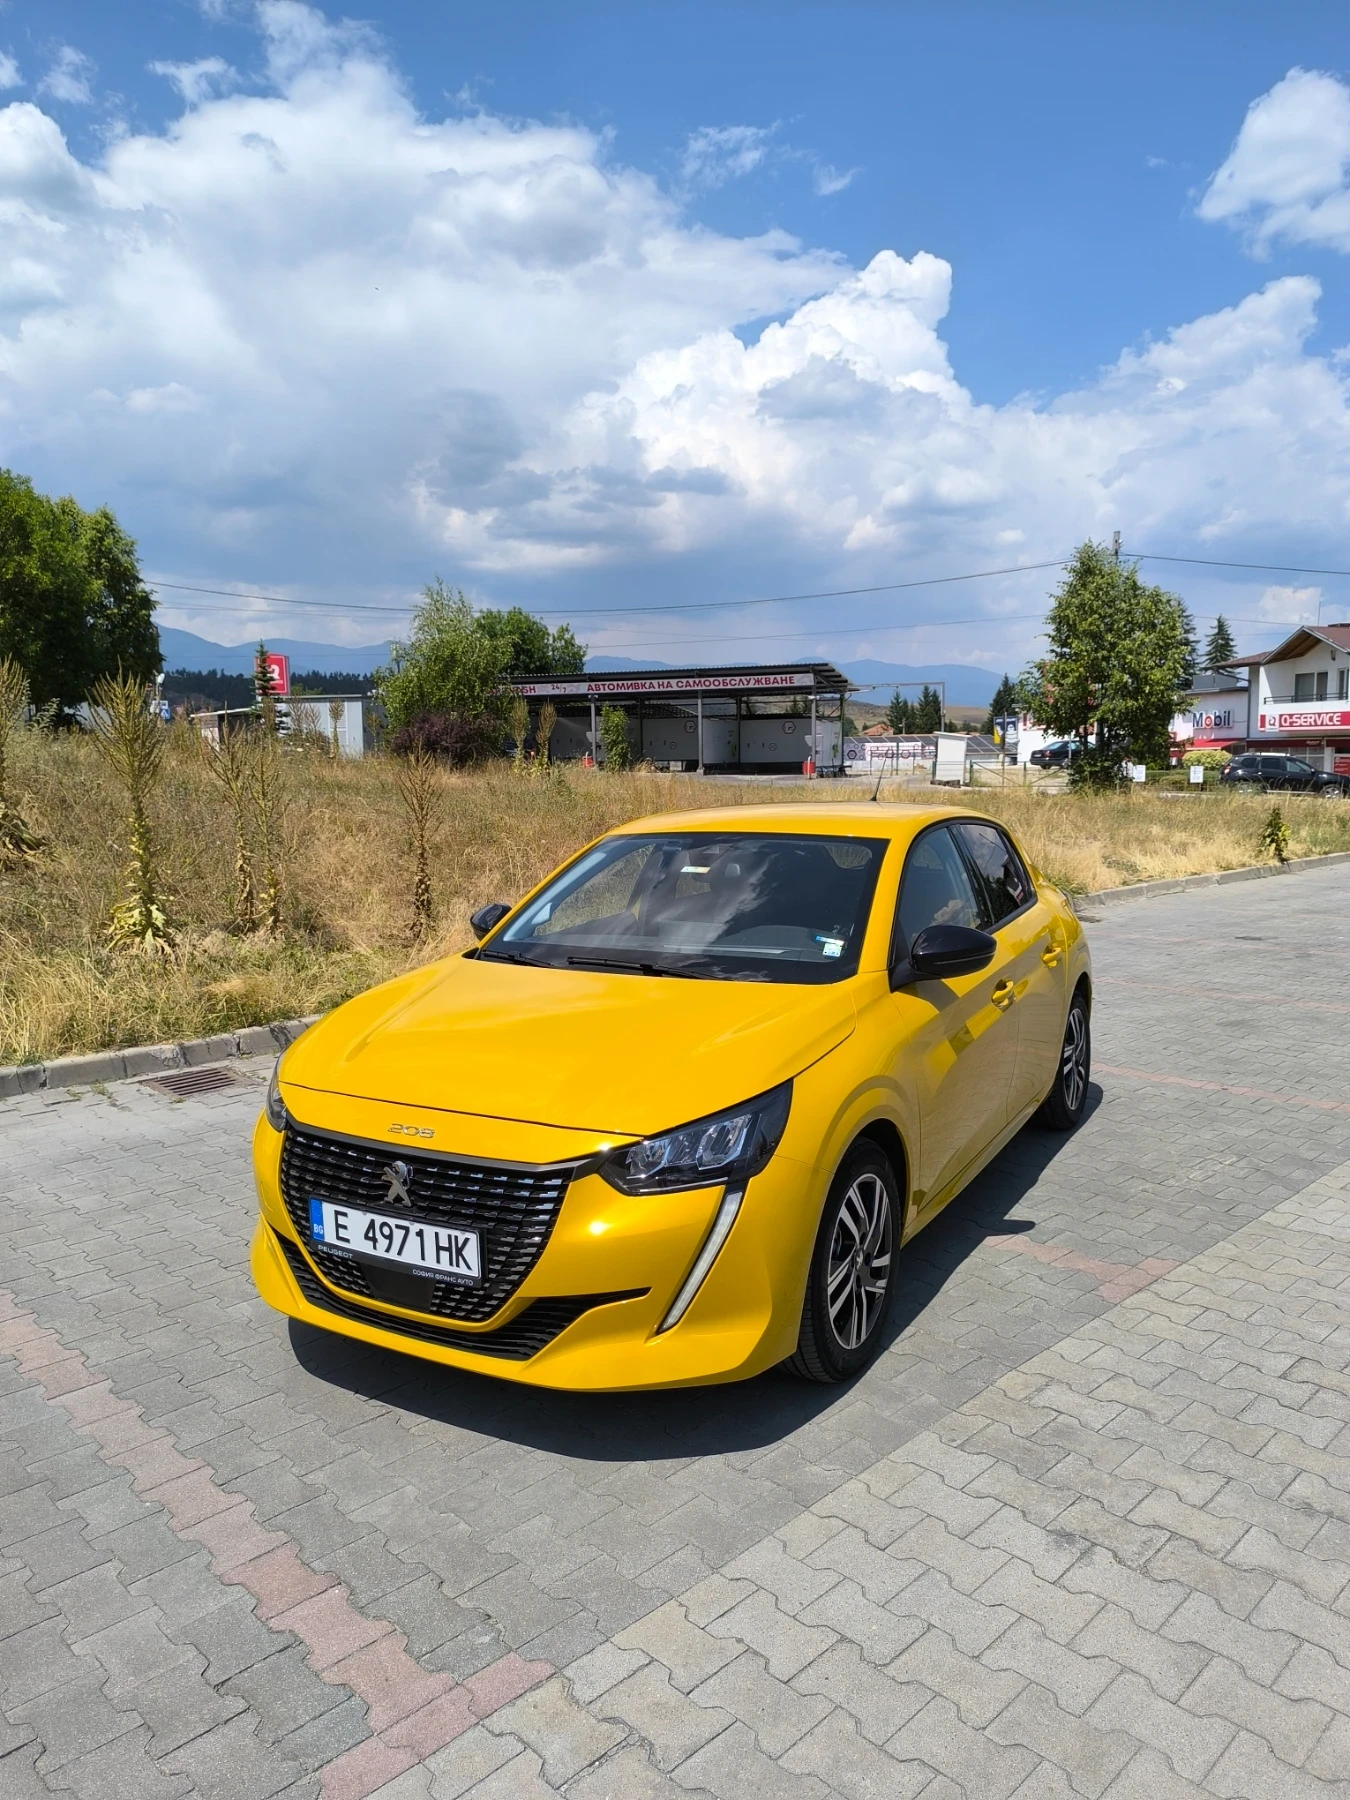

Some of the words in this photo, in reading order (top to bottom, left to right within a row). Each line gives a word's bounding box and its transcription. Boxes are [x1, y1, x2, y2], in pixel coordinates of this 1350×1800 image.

[586, 681, 656, 692] АВТОМИВКА
[657, 680, 673, 689] НА
[675, 675, 795, 689] САМООБСЛУЖВАНЕ
[1192, 710, 1231, 729] Mobil
[1281, 712, 1342, 727] Q-SERVICE
[388, 1123, 435, 1138] 208
[313, 1223, 324, 1235] BG
[334, 1209, 352, 1244] E
[363, 1218, 426, 1262] 4971
[317, 1244, 354, 1259] PEUGEOT
[412, 1268, 434, 1279] СОФИЯ
[434, 1273, 457, 1283] ФРАНС
